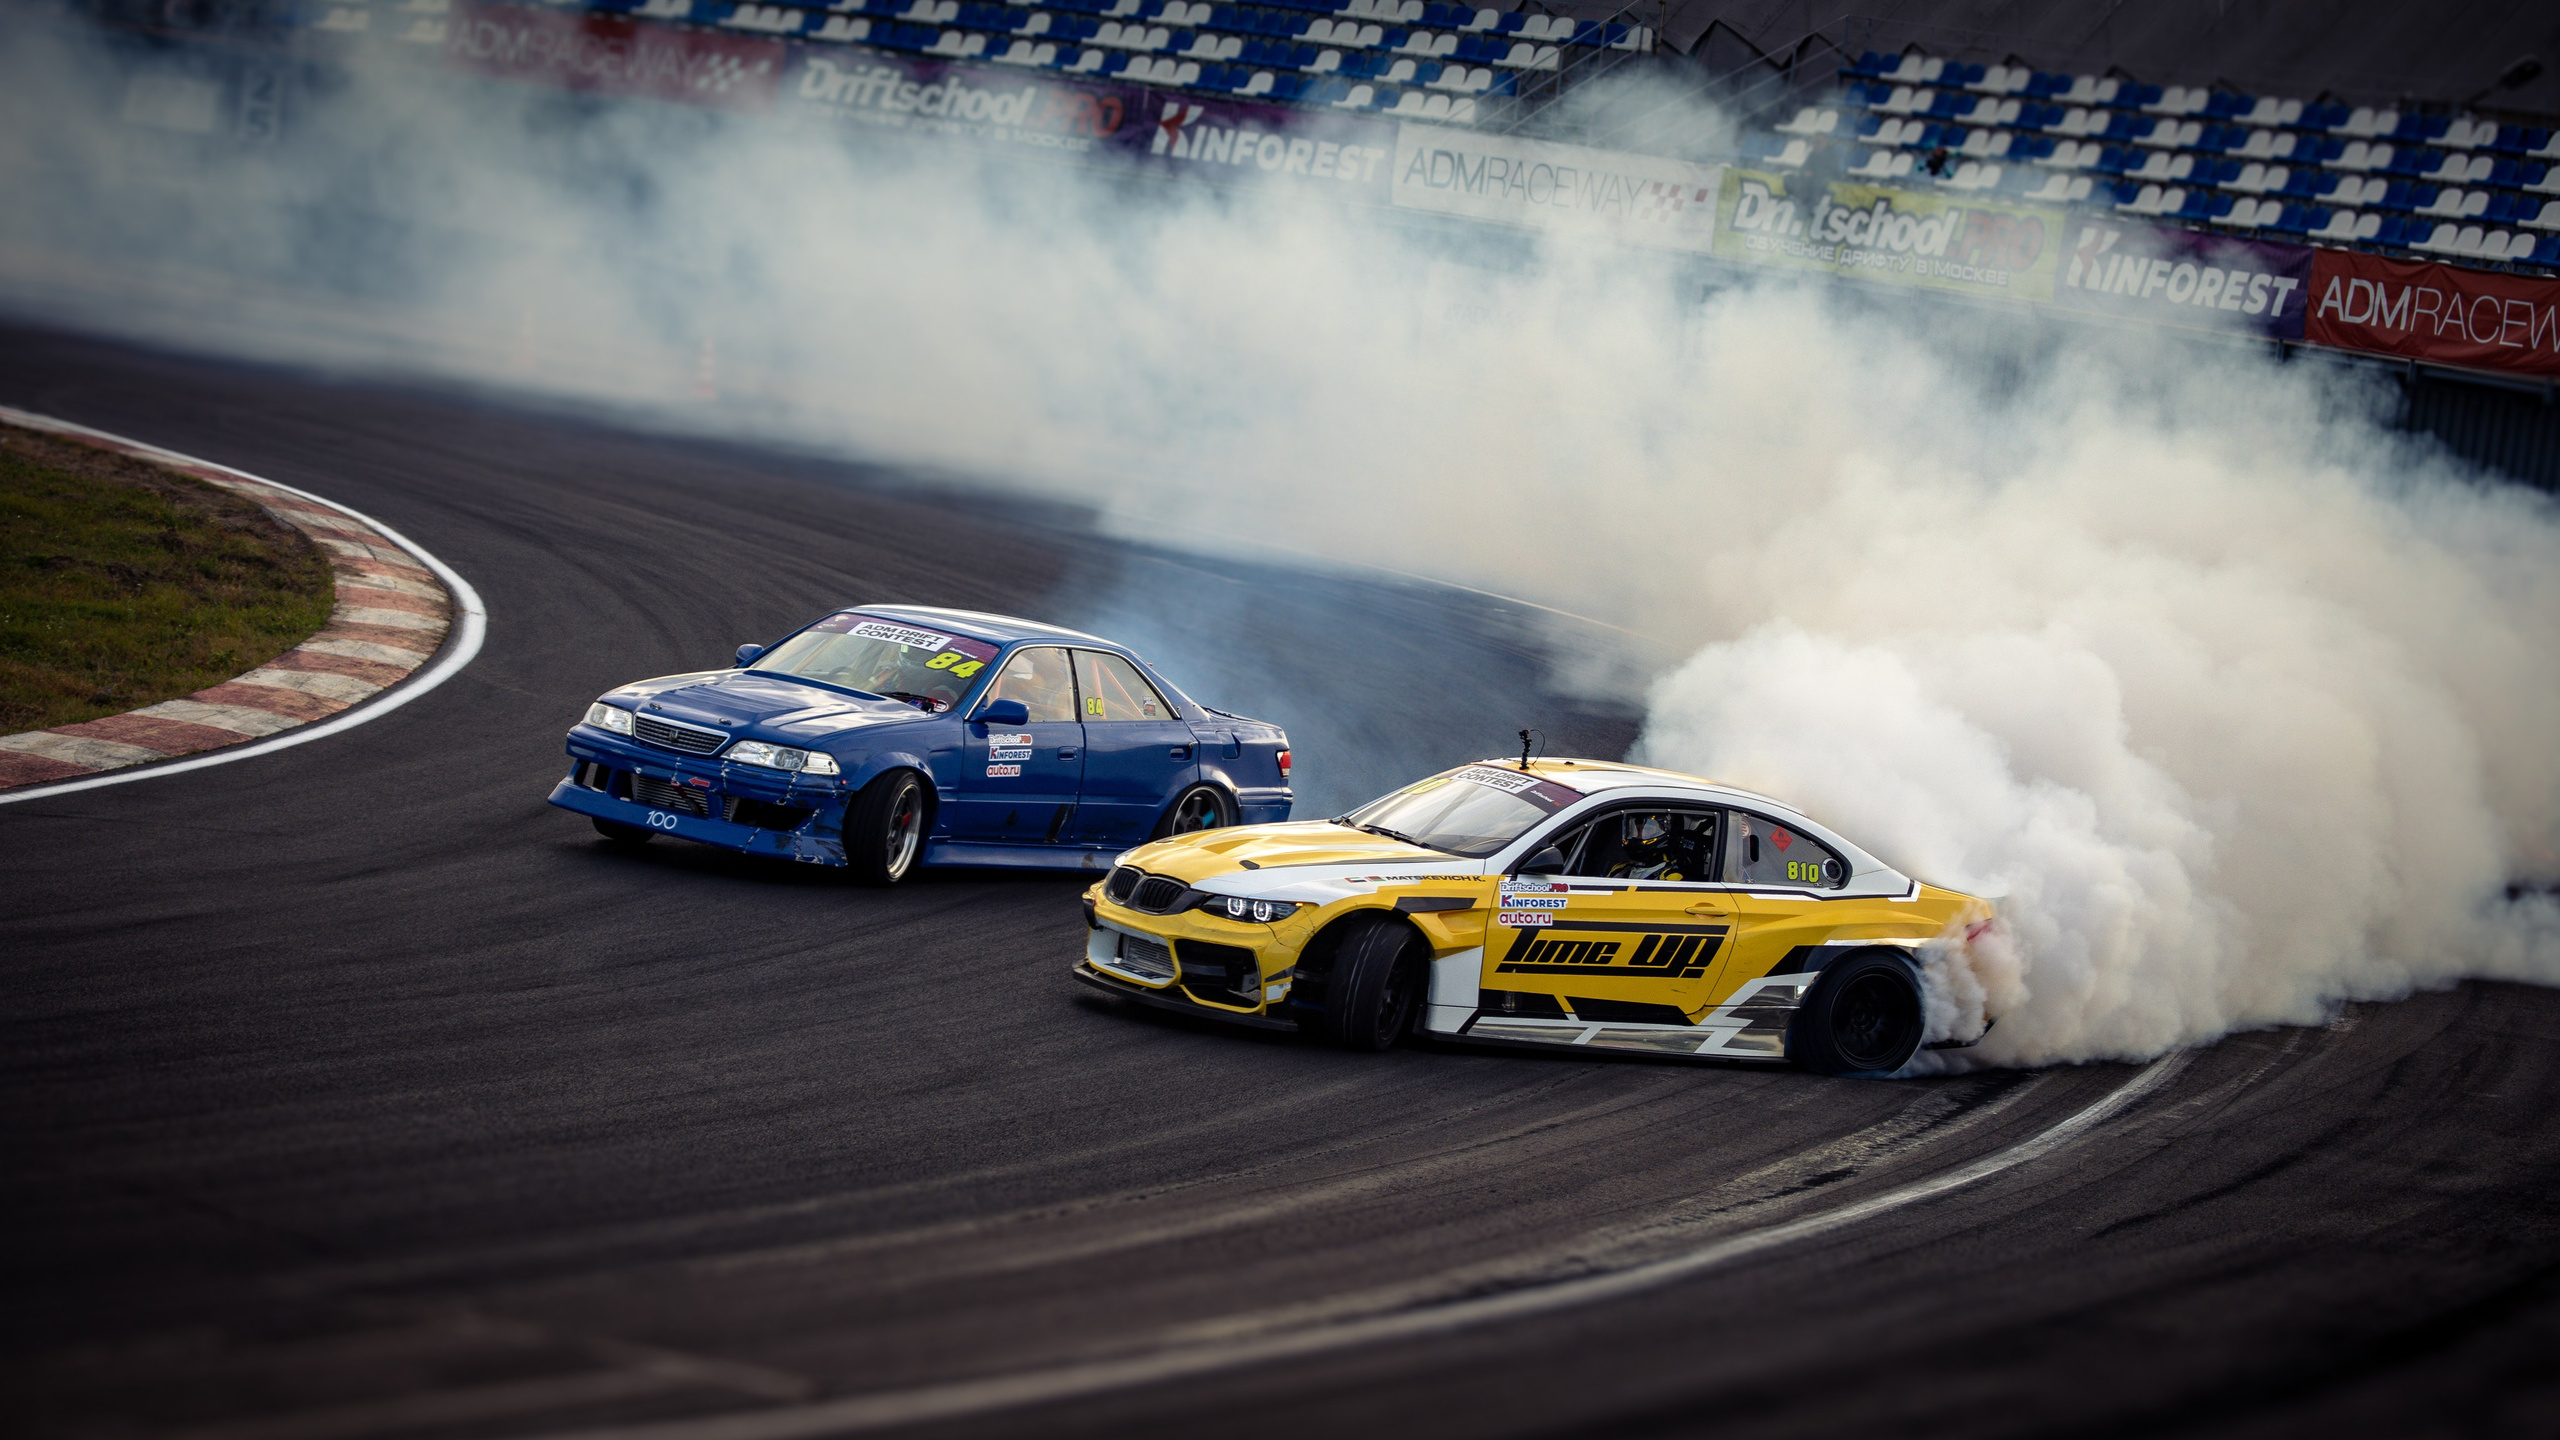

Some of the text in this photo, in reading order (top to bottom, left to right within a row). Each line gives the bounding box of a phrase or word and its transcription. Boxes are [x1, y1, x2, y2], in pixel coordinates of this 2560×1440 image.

[1403, 147, 1647, 216] ADMRACEWAY
[1934, 260, 2010, 286] МОСКВЕ
[856, 630, 938, 648] CONTEST
[863, 624, 944, 642] ADM DRIFT
[924, 652, 986, 679] 84
[1086, 697, 1104, 716] 84
[987, 764, 1020, 776] auto.ru
[1496, 772, 1534, 785] DRIFT
[1457, 771, 1523, 790] CONTEST
[646, 810, 678, 830] 100
[1787, 861, 1819, 883] 810
[1499, 912, 1552, 924] auto.ru
